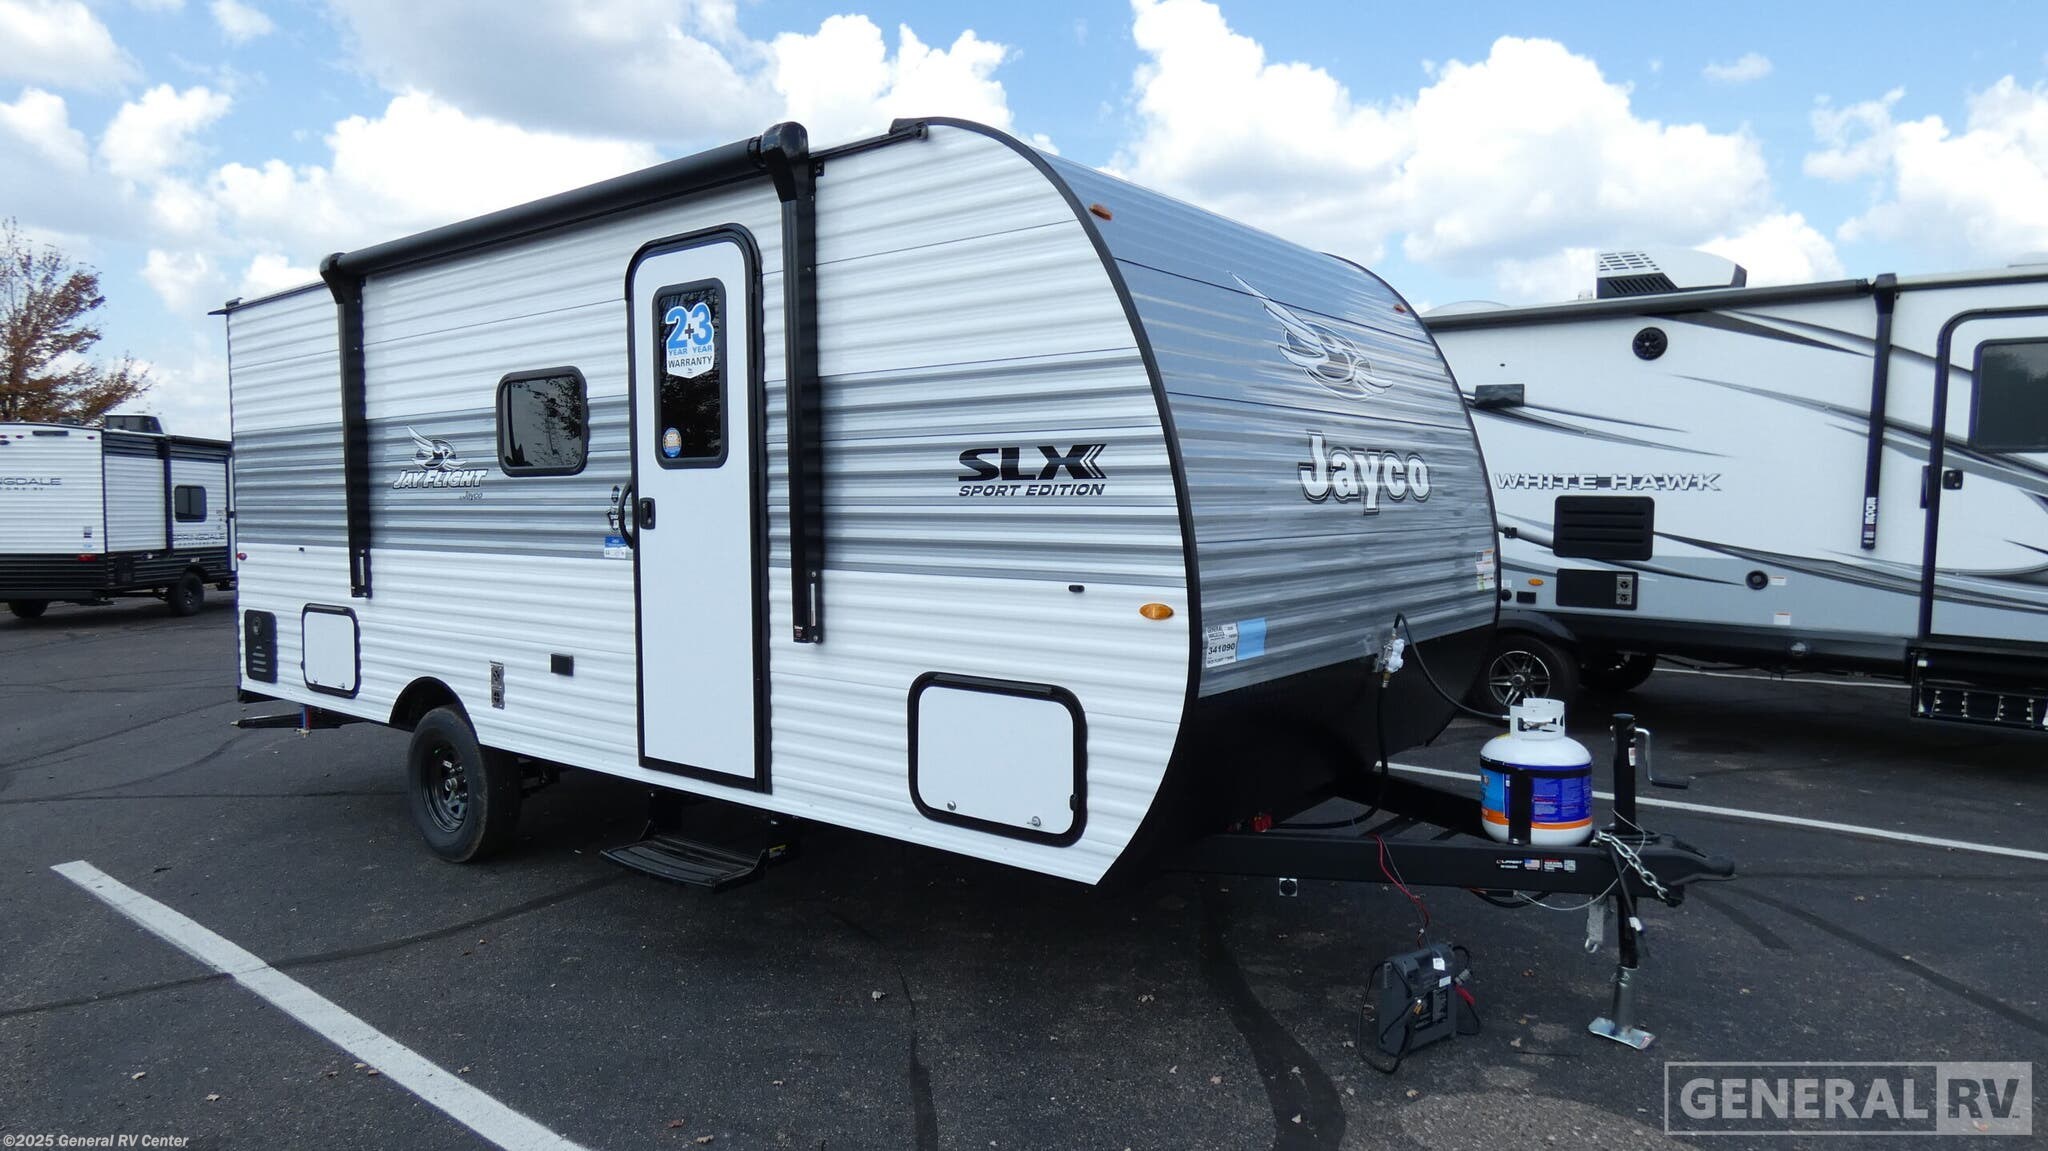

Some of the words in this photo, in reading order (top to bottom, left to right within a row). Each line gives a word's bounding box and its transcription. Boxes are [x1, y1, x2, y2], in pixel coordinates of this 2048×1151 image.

[668, 348, 688, 356] YEAR
[692, 345, 713, 354] YEAR
[668, 356, 713, 368] WARRANTY
[958, 443, 1107, 482] SLX
[1298, 429, 1432, 516] Jayco
[1494, 472, 1599, 491] WHITE
[1610, 472, 1722, 492] HAWK
[958, 484, 1022, 498] SPORT
[1025, 483, 1106, 497] EDITION
[1208, 643, 1236, 655] 341090
